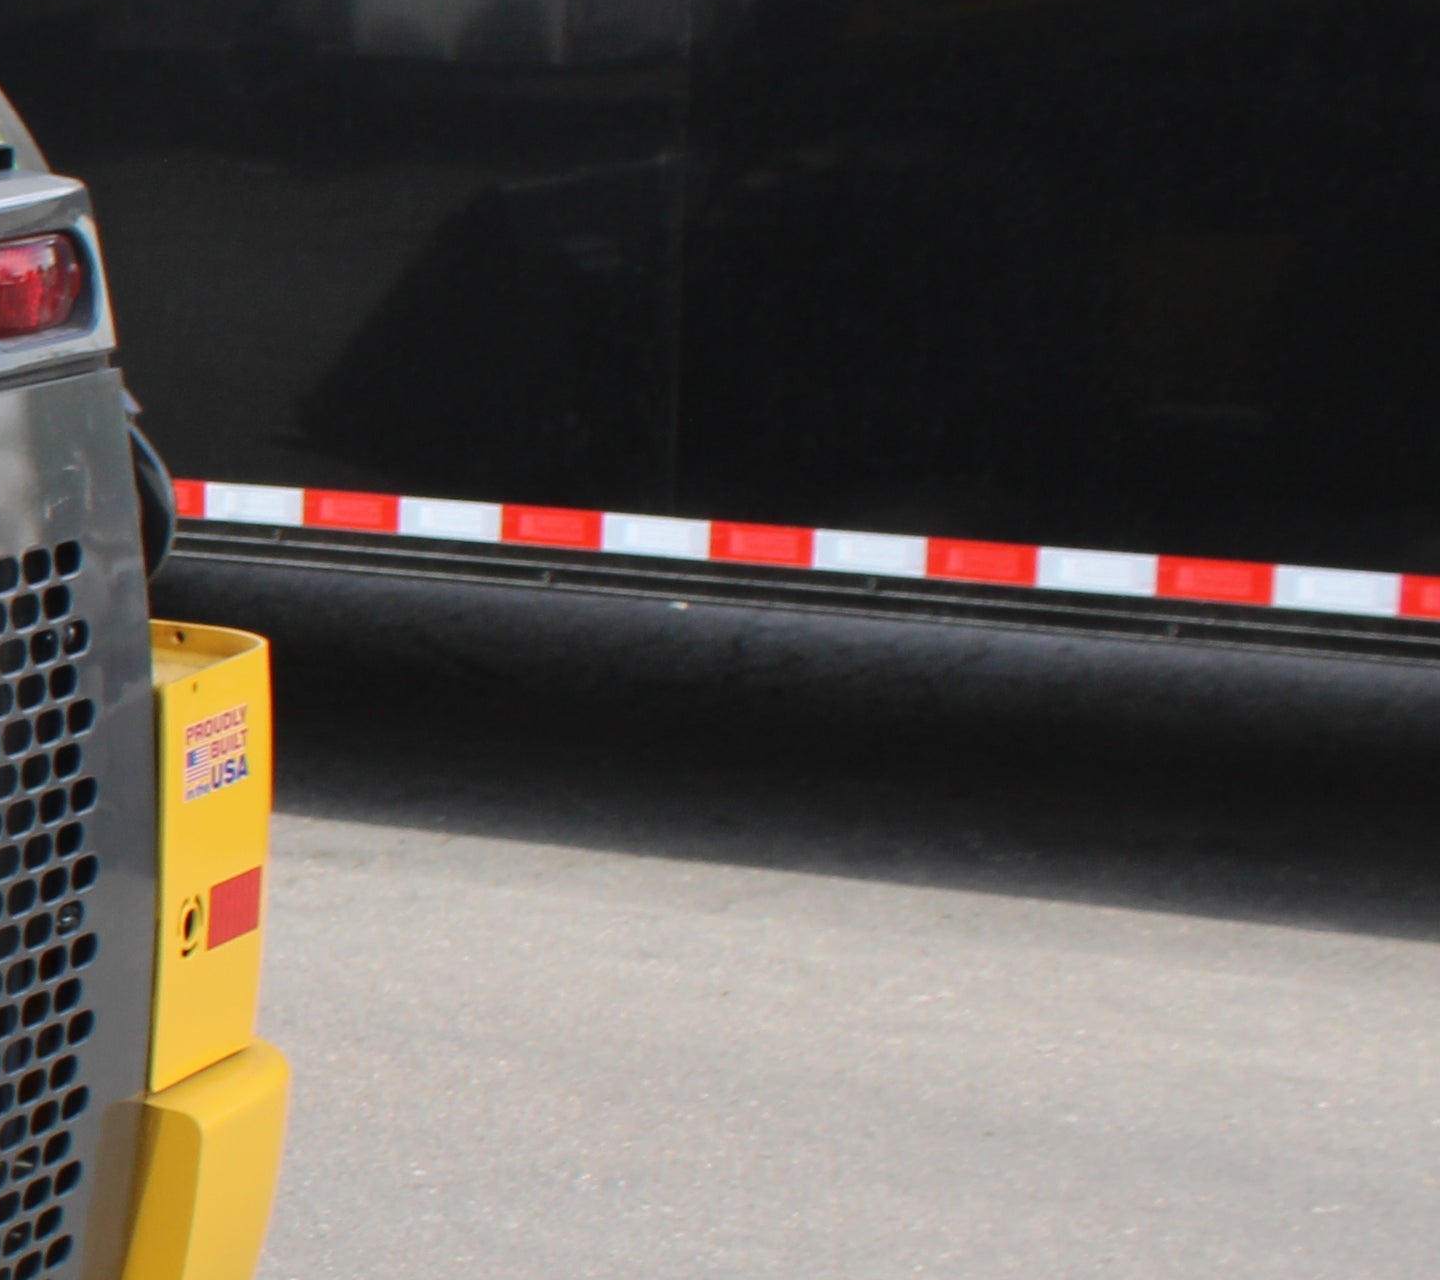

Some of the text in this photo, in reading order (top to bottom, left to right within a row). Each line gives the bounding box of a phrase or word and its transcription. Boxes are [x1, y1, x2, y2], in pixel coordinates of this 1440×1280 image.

[185, 704, 249, 746] PROUDLY
[210, 727, 248, 759] BUILT
[211, 752, 249, 789] USA
